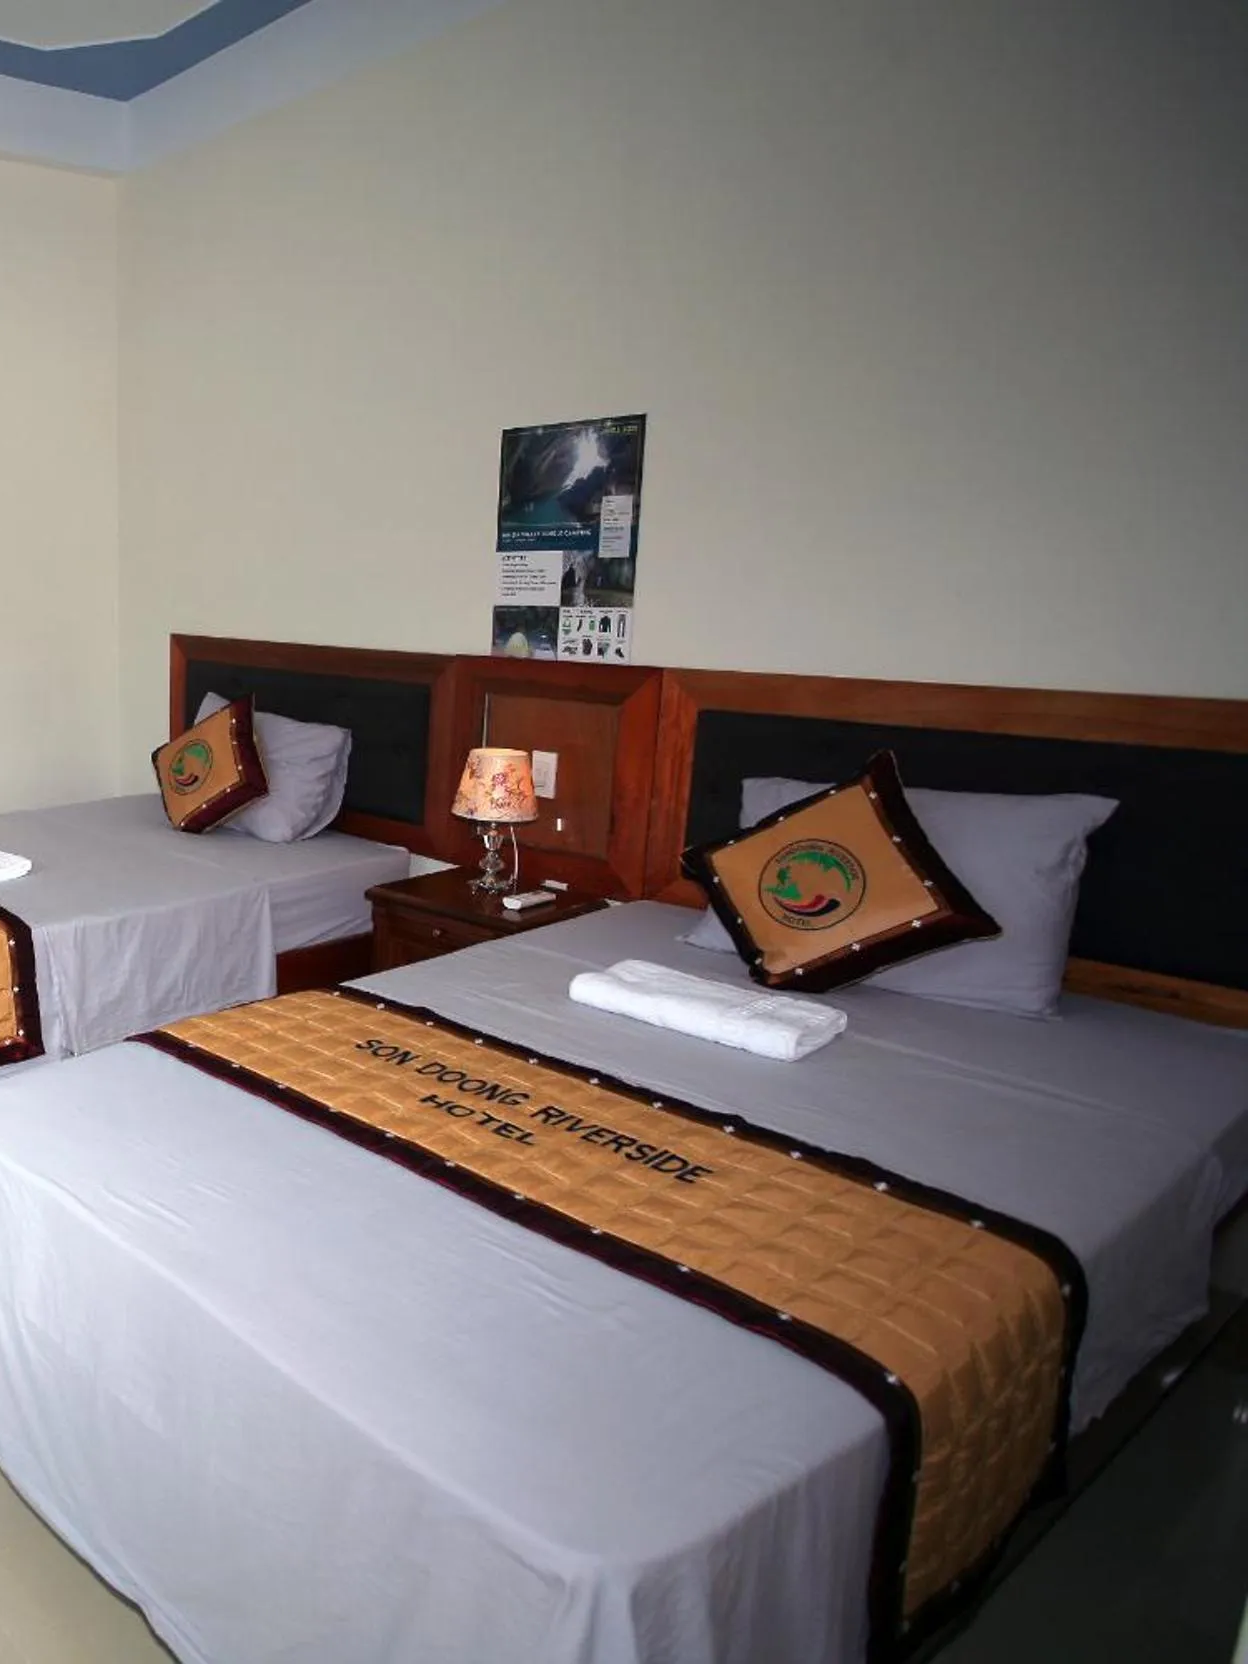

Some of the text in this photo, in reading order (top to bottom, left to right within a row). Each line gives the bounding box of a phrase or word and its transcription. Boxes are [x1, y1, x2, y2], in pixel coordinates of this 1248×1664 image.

[355, 1038, 714, 1185] SON DOONG RIVERSIDE
[418, 1094, 540, 1147] HOTEL
